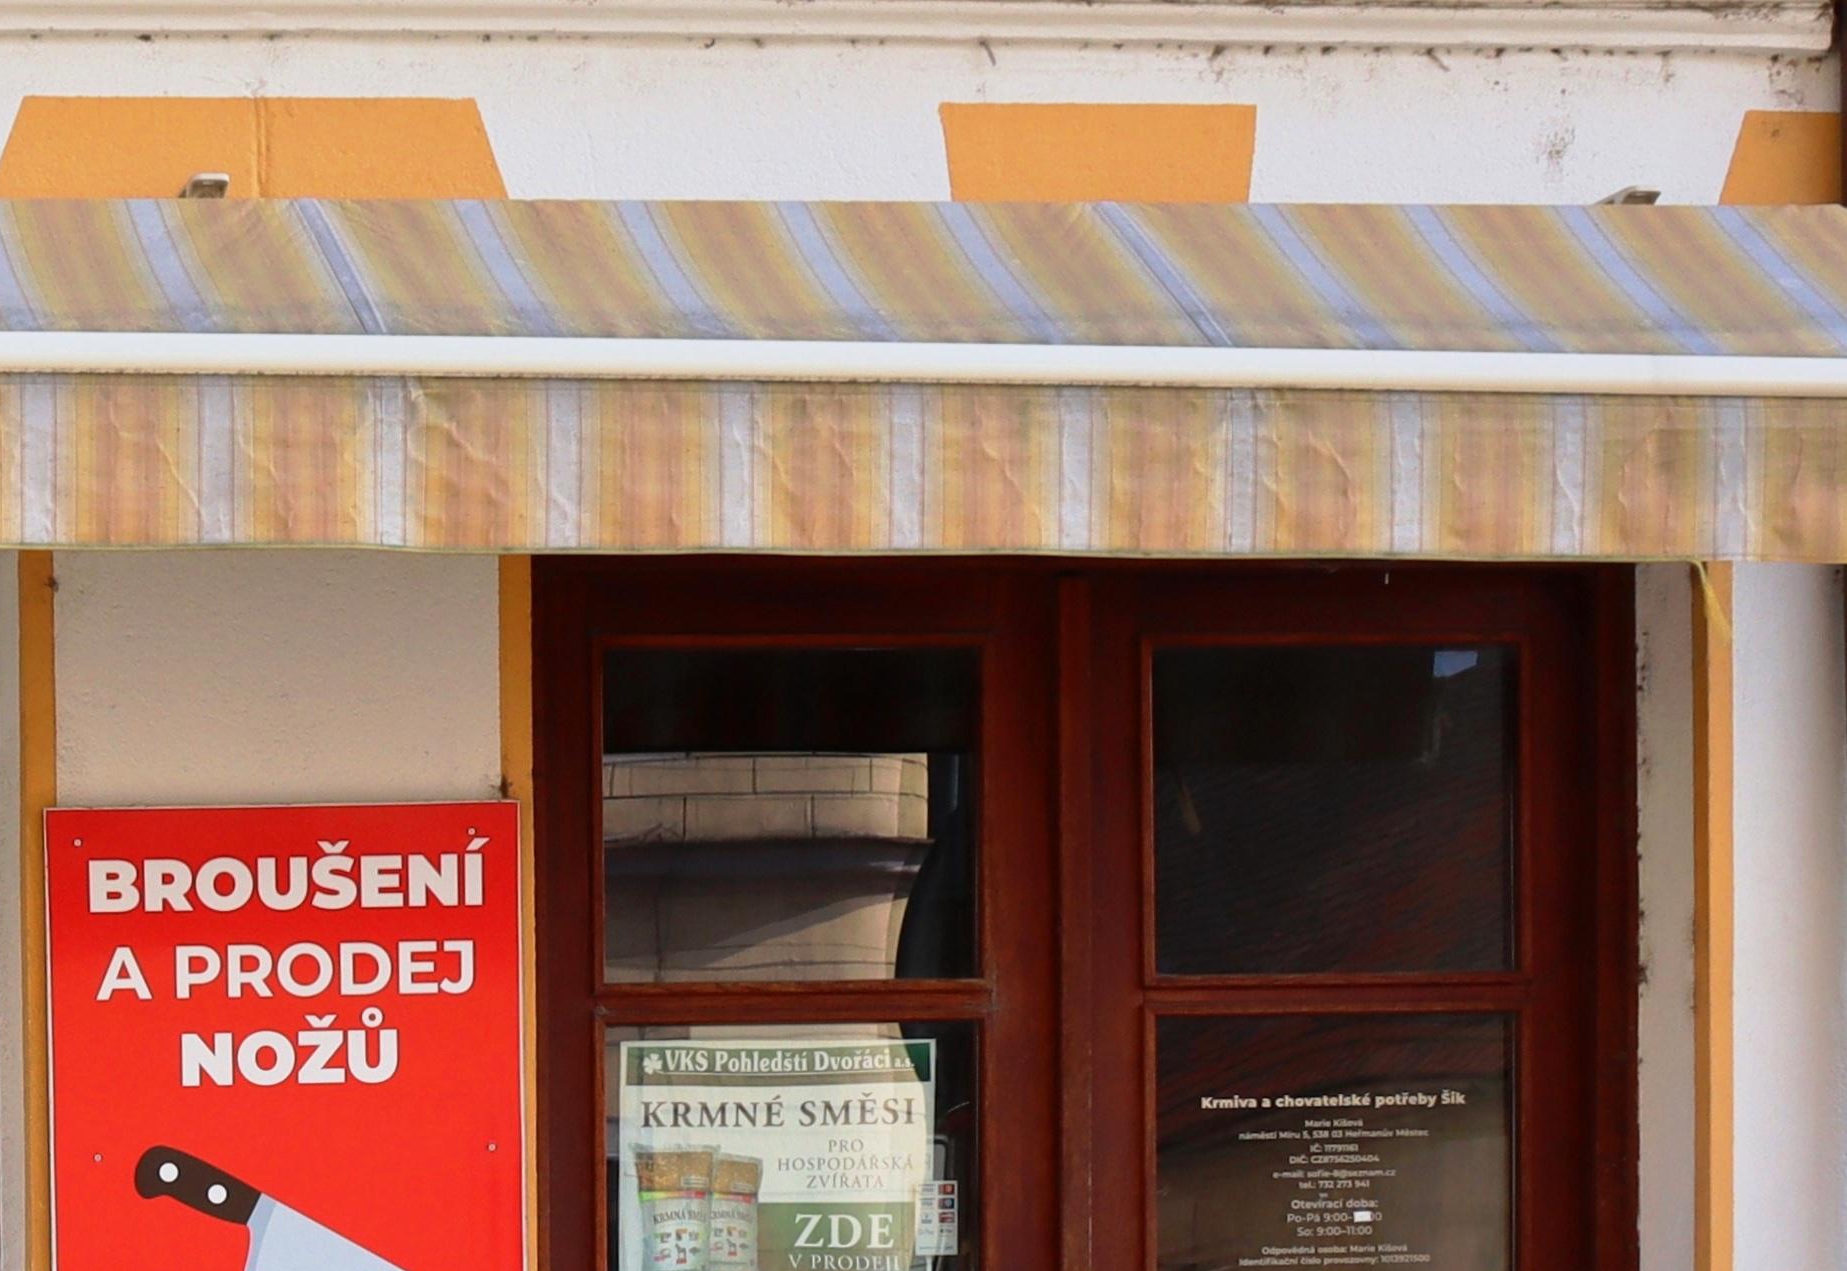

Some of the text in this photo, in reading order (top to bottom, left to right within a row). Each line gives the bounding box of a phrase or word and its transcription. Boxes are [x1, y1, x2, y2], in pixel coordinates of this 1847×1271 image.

[88, 837, 491, 914] BROUŠENÍ
[95, 939, 475, 1001] A PRODEJ
[180, 1006, 400, 1087] NOŽŮ
[664, 1051, 708, 1072] VKS
[714, 1050, 808, 1073] Pohledští
[1201, 1089, 1466, 1109] Krmiva a chovatelské potřeby Šik
[641, 1092, 916, 1128] KRMNÉ SMĚSI
[1305, 1119, 1331, 1128] Marie
[829, 1139, 864, 1152] PRO
[778, 1152, 914, 1172] HOSPODÁŘSKÁ
[806, 1170, 885, 1189] ZVÍŘATA
[1291, 1198, 1378, 1210] Otevírací doba:
[794, 1213, 895, 1249] ZDE
[1297, 1227, 1314, 1237] So:
[788, 1255, 803, 1269] V
